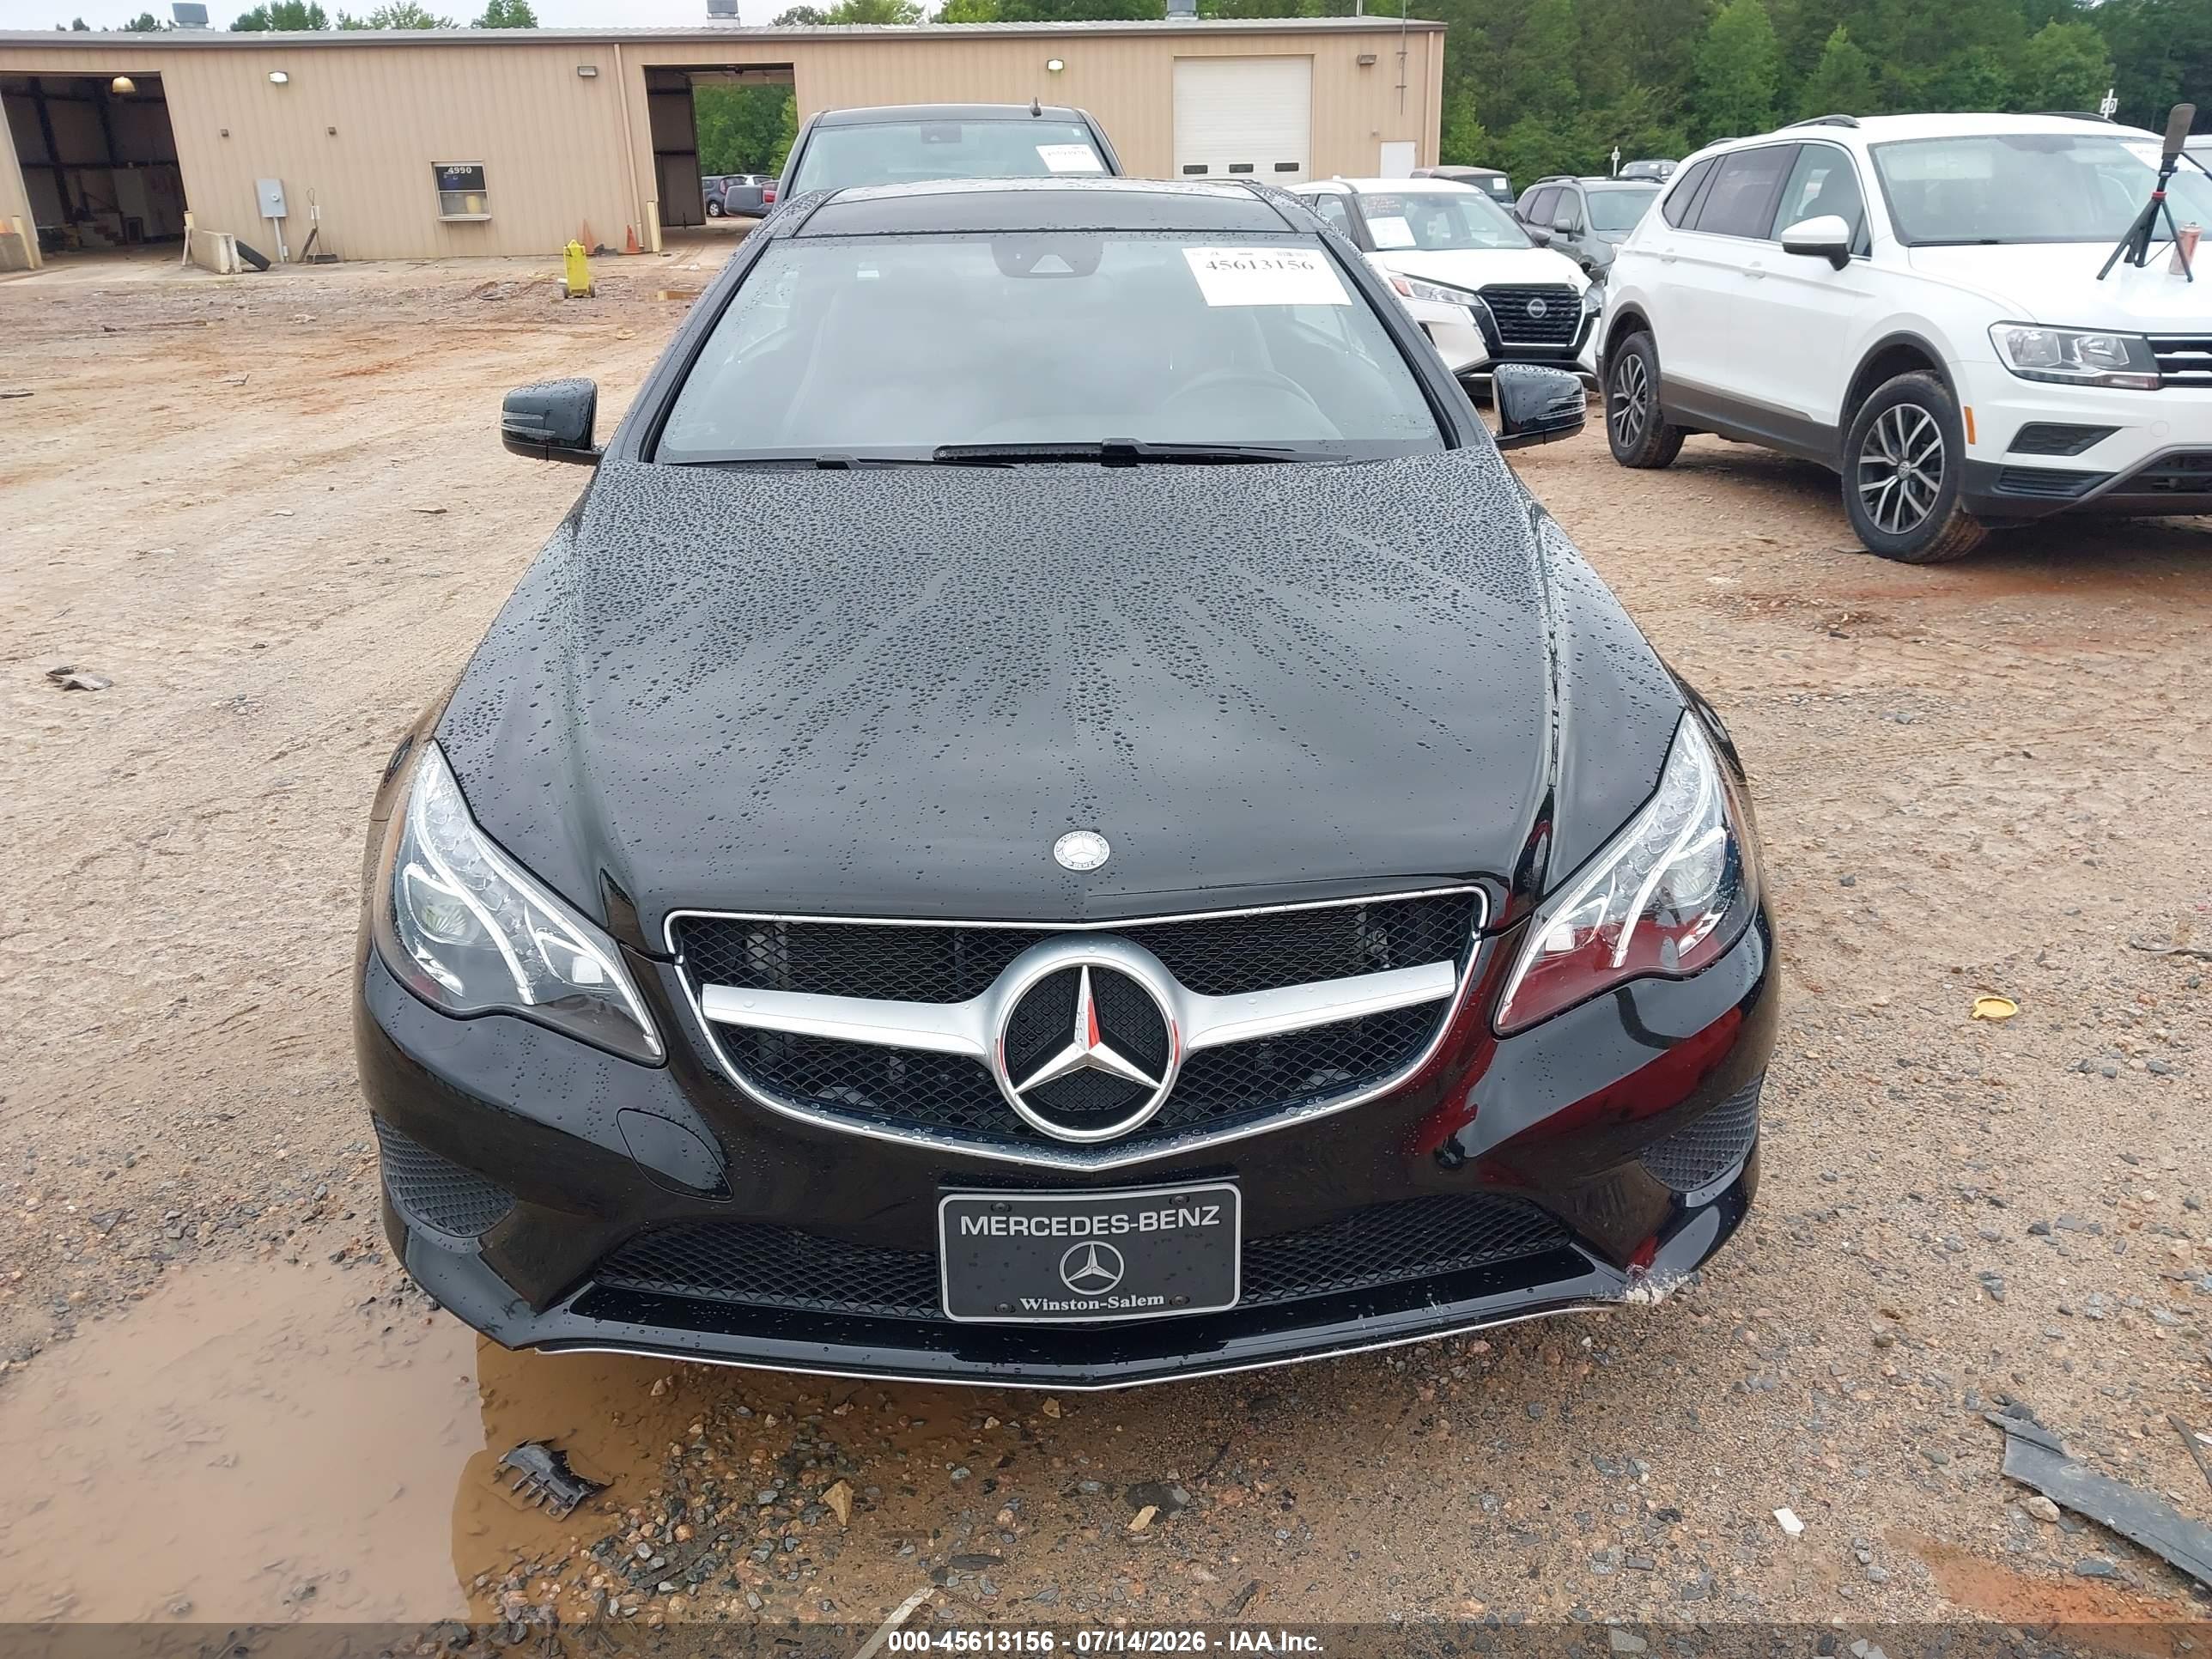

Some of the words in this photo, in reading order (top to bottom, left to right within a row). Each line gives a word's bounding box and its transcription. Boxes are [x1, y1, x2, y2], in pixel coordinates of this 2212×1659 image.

[1206, 259, 1315, 271] 45613156
[960, 1205, 1221, 1237] MERCEDES-BENZ
[1019, 1293, 1165, 1312] Winston-Salem
